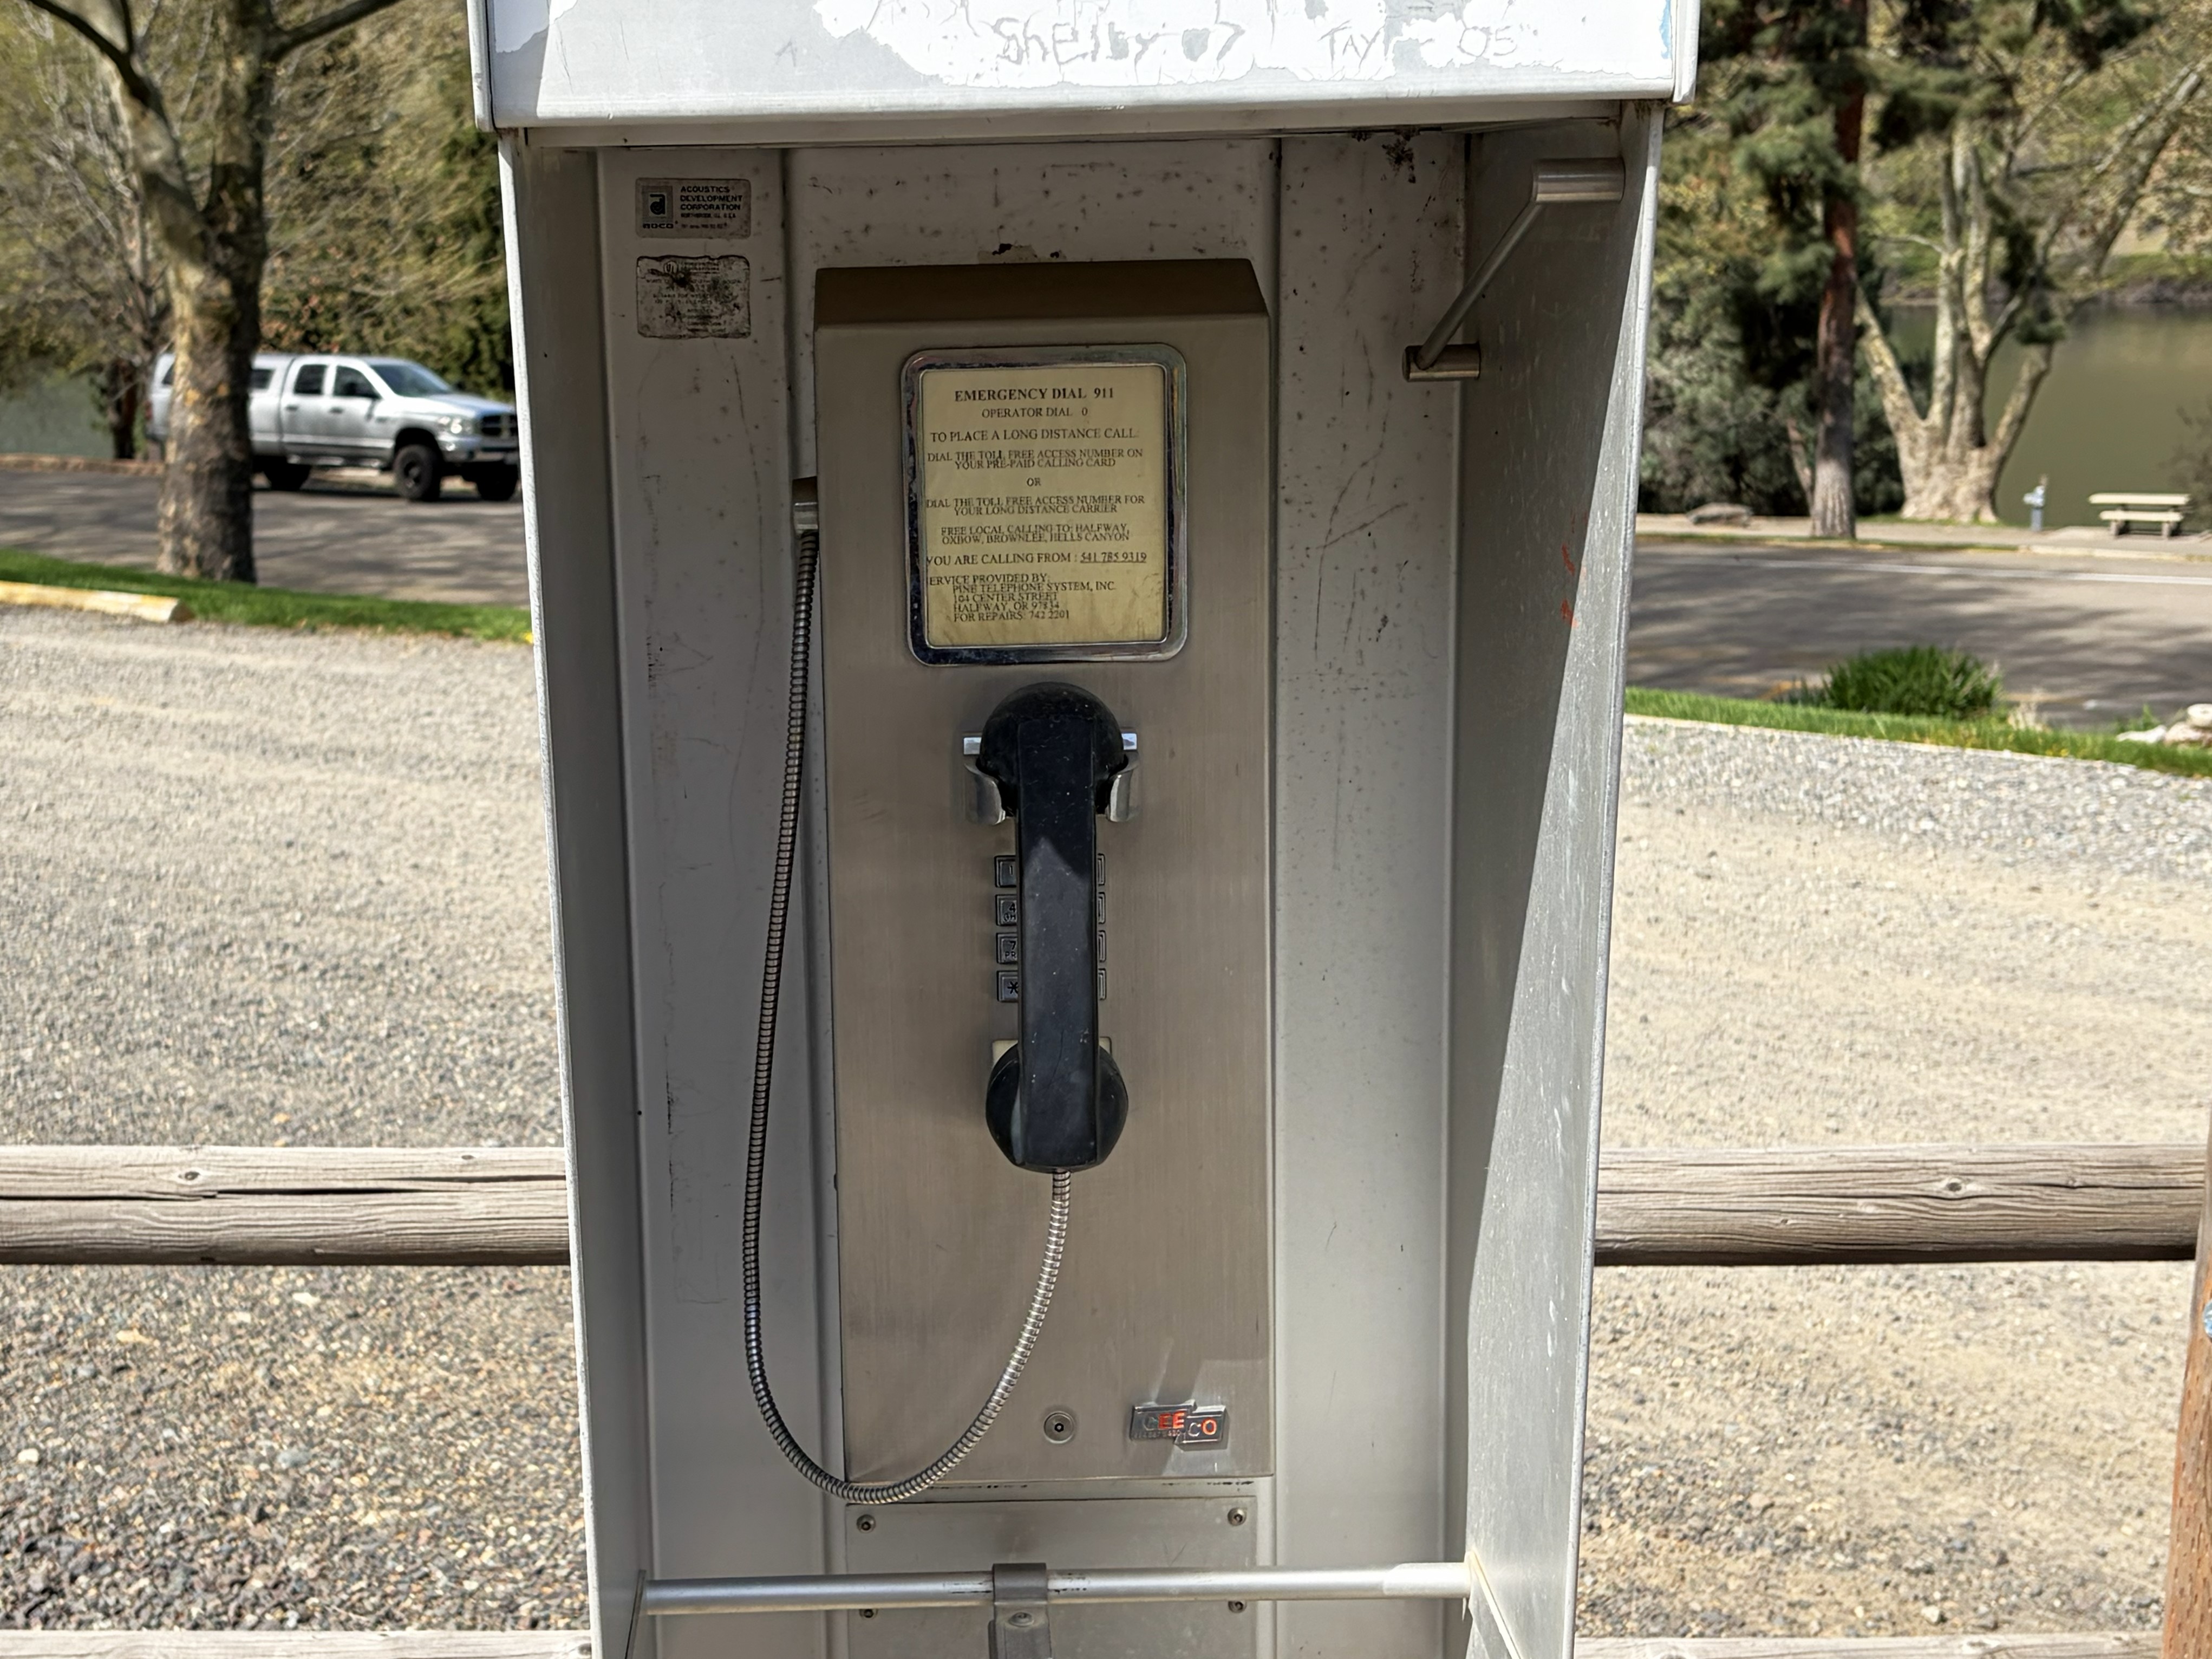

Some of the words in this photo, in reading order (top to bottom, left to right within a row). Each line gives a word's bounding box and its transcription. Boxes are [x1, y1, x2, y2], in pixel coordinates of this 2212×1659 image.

[955, 388, 1048, 402] EMERGENCY
[1053, 388, 1086, 399] DIAL
[1094, 387, 1114, 399] 911
[982, 408, 1043, 418] OPERATOR
[1046, 407, 1073, 417] DIAL
[1081, 407, 1088, 416] 0
[930, 432, 947, 443] TO
[950, 431, 988, 441] PLACE
[991, 431, 1000, 440] A
[1003, 429, 1038, 440] LONG
[1041, 428, 1101, 439] DISTANCE
[928, 452, 952, 462] DIAL
[955, 451, 976, 461] THE
[978, 450, 1006, 460] TOLL
[1008, 450, 1034, 459] FREE
[1037, 449, 1076, 458] ACCESS
[1079, 448, 1125, 458] NUMBER
[1127, 448, 1143, 458] ON
[955, 460, 984, 470] YOUR
[987, 459, 1035, 470] PRE-PAID
[1038, 458, 1084, 468] CALLING
[1086, 458, 1116, 467] CARD
[1026, 477, 1041, 487] OR
[926, 499, 950, 508] DIAL
[954, 498, 974, 507] THE
[977, 497, 1003, 506] TOLL
[1006, 497, 1032, 506] FREE
[1035, 496, 1074, 505] ACCESS
[1077, 495, 1122, 505] NUMBER
[1125, 495, 1145, 504] FOR
[954, 506, 983, 516] YOUR
[986, 505, 1015, 515] LONG
[1017, 505, 1070, 515] DISTANCE
[1072, 504, 1118, 513] CARRIER
[941, 526, 967, 536] FREE
[969, 525, 1004, 535] LOCAL
[1007, 524, 1053, 534] CALLING
[1050, 532, 1082, 542] HELLS
[926, 555, 951, 566] YOU
[955, 554, 978, 565] ARE
[981, 554, 1034, 564] CALLING
[1037, 552, 1071, 563] FROM
[1080, 552, 1097, 563] 541
[1101, 552, 1119, 562] 785
[1122, 551, 1147, 562] 9319
[929, 575, 969, 585] ERVICE
[973, 574, 1029, 583] PROVIDED
[954, 584, 977, 594] PINE
[981, 583, 1044, 593] TELEPHONE
[973, 593, 1015, 602] CENTER
[1018, 591, 1058, 601] STREET
[1014, 601, 1028, 610] OR
[954, 613, 975, 622] FOR
[1030, 611, 1045, 620] 742
[1049, 610, 1069, 620] 2201
